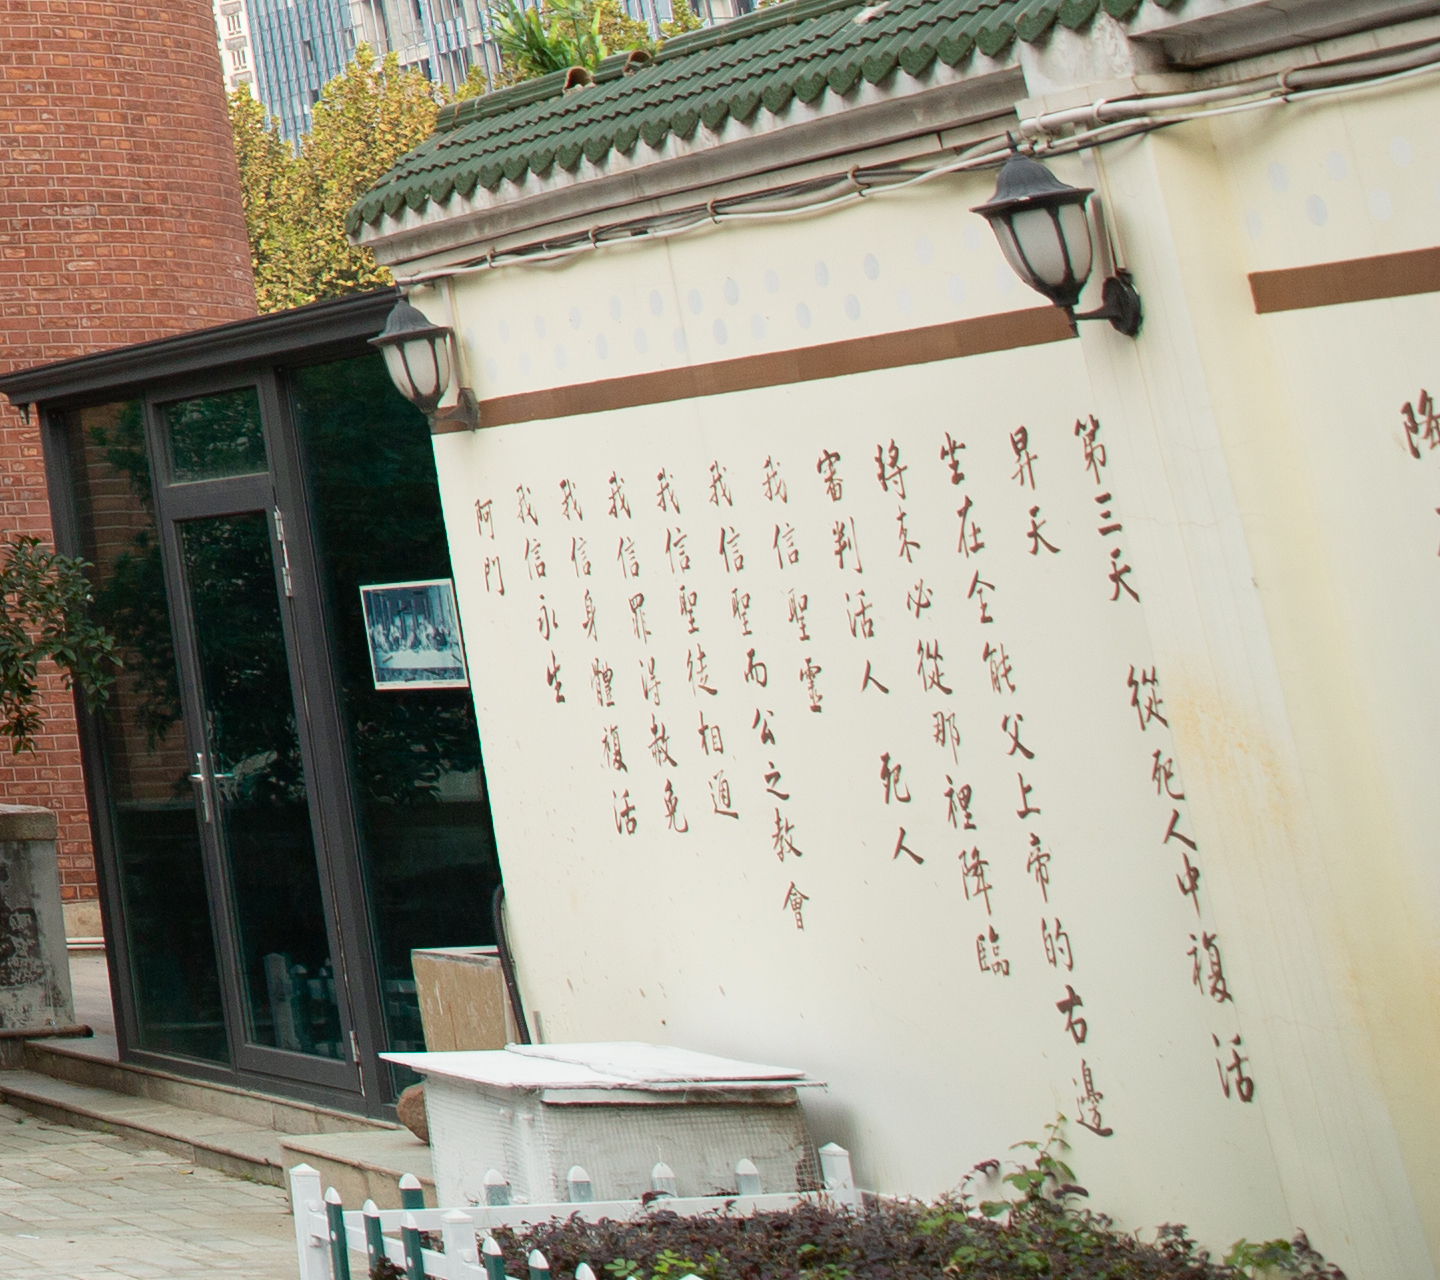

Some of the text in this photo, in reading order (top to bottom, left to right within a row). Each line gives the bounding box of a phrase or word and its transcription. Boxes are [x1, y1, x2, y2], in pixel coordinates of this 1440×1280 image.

[475, 499, 505, 597] 阿門
[1074, 414, 1141, 604] 第三天
[516, 485, 566, 704] 我信永生
[880, 752, 925, 866] 死人
